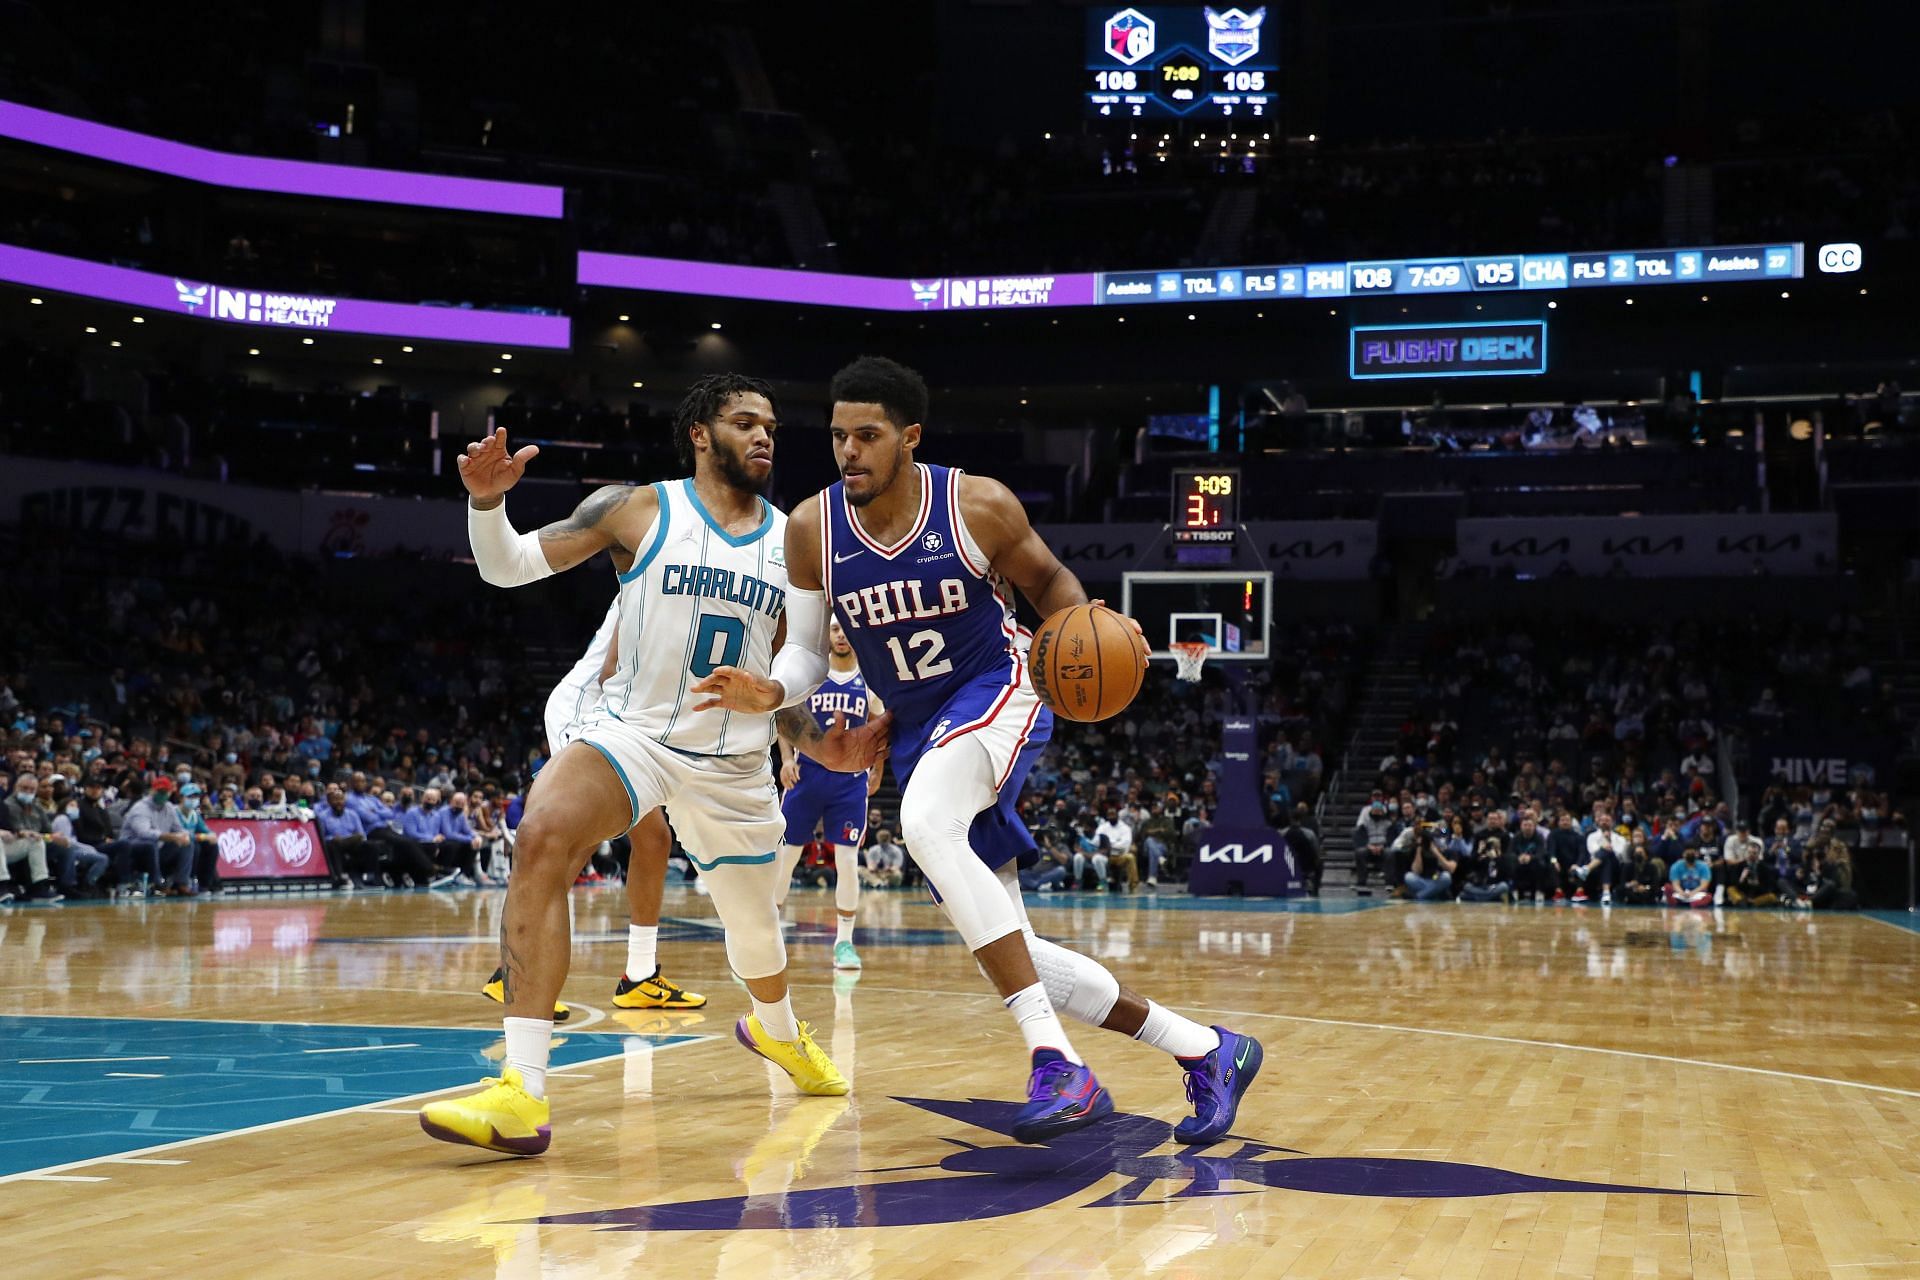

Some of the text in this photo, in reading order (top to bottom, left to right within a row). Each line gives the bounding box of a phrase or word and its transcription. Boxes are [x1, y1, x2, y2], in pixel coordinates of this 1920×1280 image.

[1095, 71, 1137, 90] 108
[1163, 66, 1200, 81] 7:09
[1223, 72, 1265, 91] 105
[1100, 105, 1111, 116] 4
[1132, 105, 1142, 116] 2
[1224, 105, 1233, 116] 3
[1254, 105, 1263, 116] 2
[1825, 250, 1855, 267] CC
[1184, 278, 1216, 293] TOL
[1220, 277, 1233, 292] 4
[1246, 275, 1275, 291] FLS
[1282, 274, 1295, 290] 2
[1307, 271, 1344, 290] PHI
[1353, 269, 1392, 289] 108
[1409, 266, 1460, 286] 7:09
[1476, 263, 1514, 284] 105
[1524, 262, 1564, 281] CHA
[1573, 262, 1605, 278] FLS
[1614, 260, 1627, 277] 2
[1636, 260, 1671, 276] TOL
[1681, 257, 1696, 275] 3
[1708, 256, 1759, 271] Assists
[992, 278, 1055, 293] NOVANT
[265, 295, 337, 314] NOVANT
[992, 291, 1049, 305] HEALTH
[265, 310, 328, 327] HEALTH
[1363, 336, 1535, 364] FLIGHT DECK
[1194, 475, 1232, 496] 7:09
[1191, 531, 1235, 541] TISSOT
[917, 551, 955, 565] crypto.com
[837, 578, 968, 629] PHILA
[690, 613, 745, 679] 0
[886, 629, 954, 682] 12
[811, 692, 866, 718] PHILA
[1771, 757, 1848, 784] HIVE
[842, 828, 860, 842] 76
[1200, 844, 1273, 864] KIA
